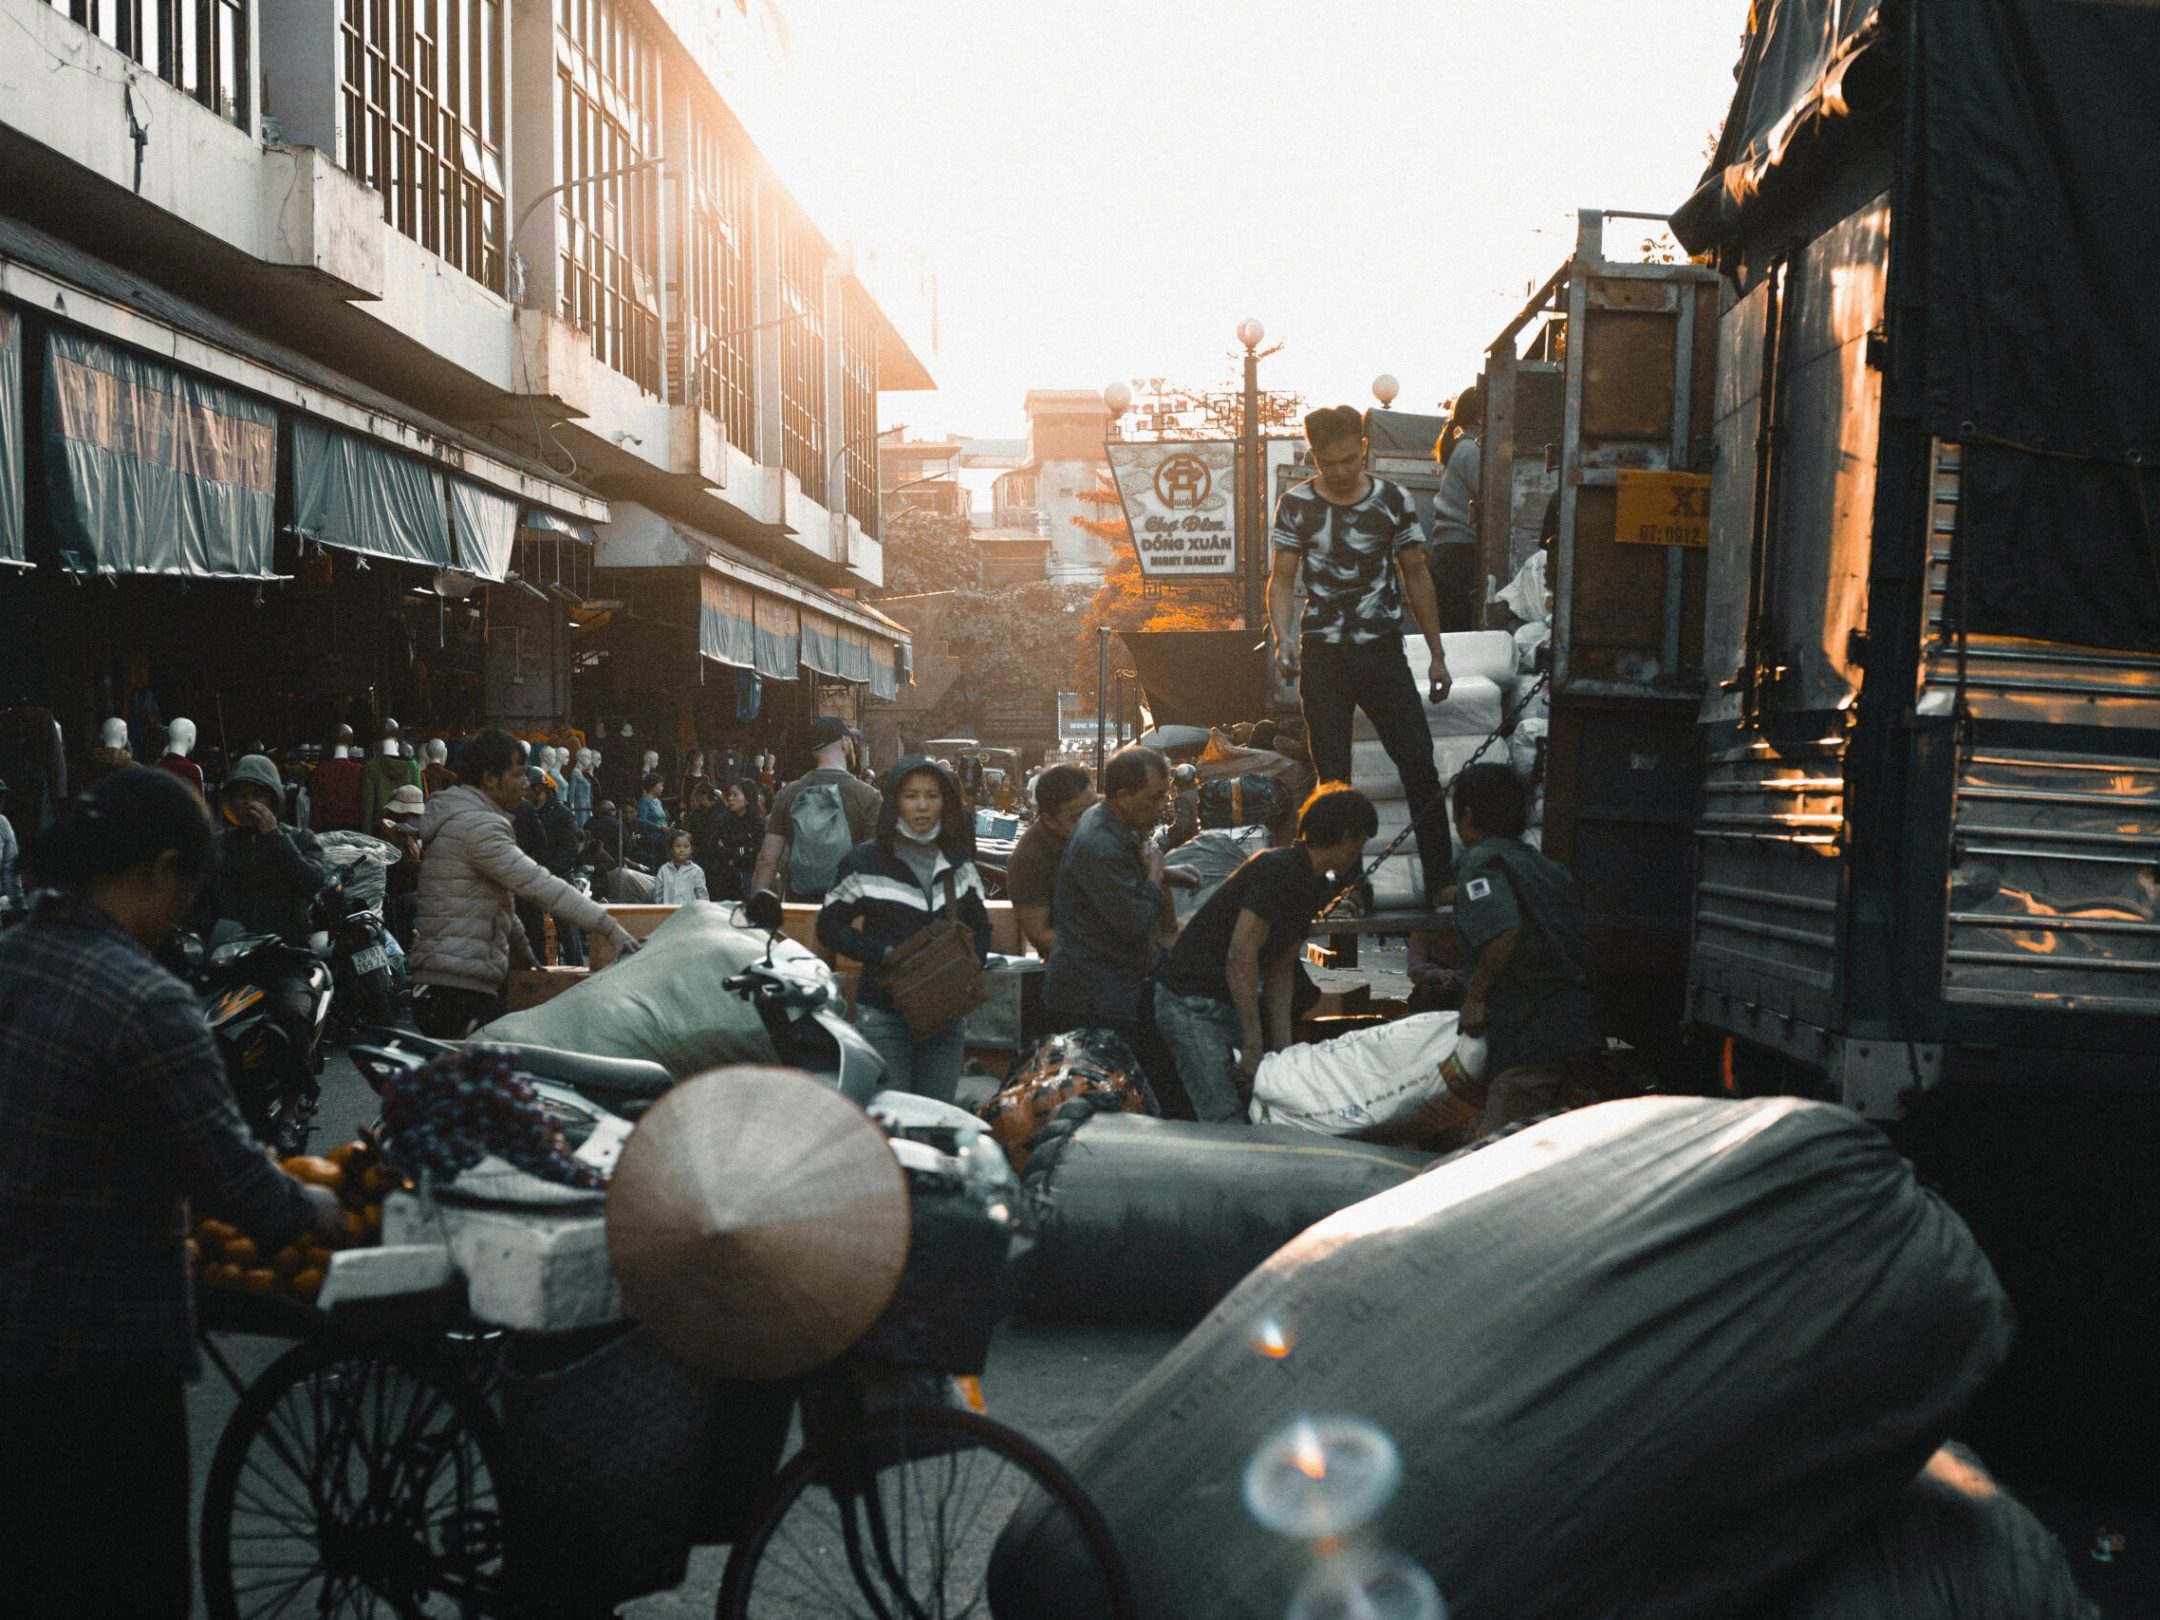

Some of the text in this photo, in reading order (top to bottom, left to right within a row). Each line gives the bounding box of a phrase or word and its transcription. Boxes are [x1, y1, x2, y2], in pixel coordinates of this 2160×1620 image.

[1187, 534, 1231, 550] XUÂN
[1151, 555, 1226, 566] NIGHT MARKET
